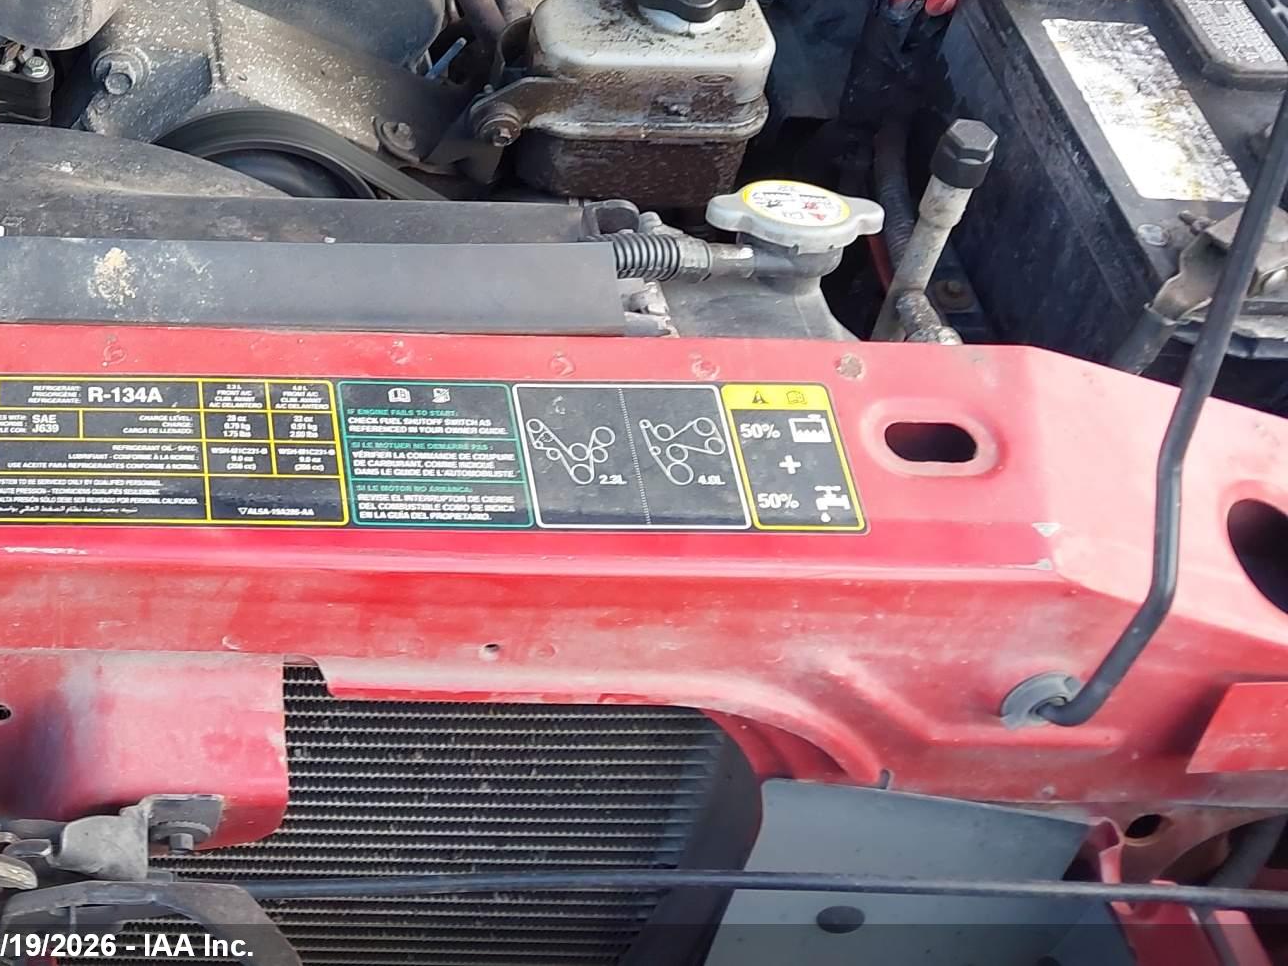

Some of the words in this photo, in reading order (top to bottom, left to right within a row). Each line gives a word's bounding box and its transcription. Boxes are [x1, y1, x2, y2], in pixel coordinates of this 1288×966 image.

[87, 386, 164, 403] R-134A
[32, 414, 57, 424] SAE
[31, 424, 60, 434] J639
[740, 423, 782, 440] 50%
[599, 474, 628, 485] 2.3L
[697, 475, 726, 486] 4.0L
[757, 492, 800, 510] 50%
